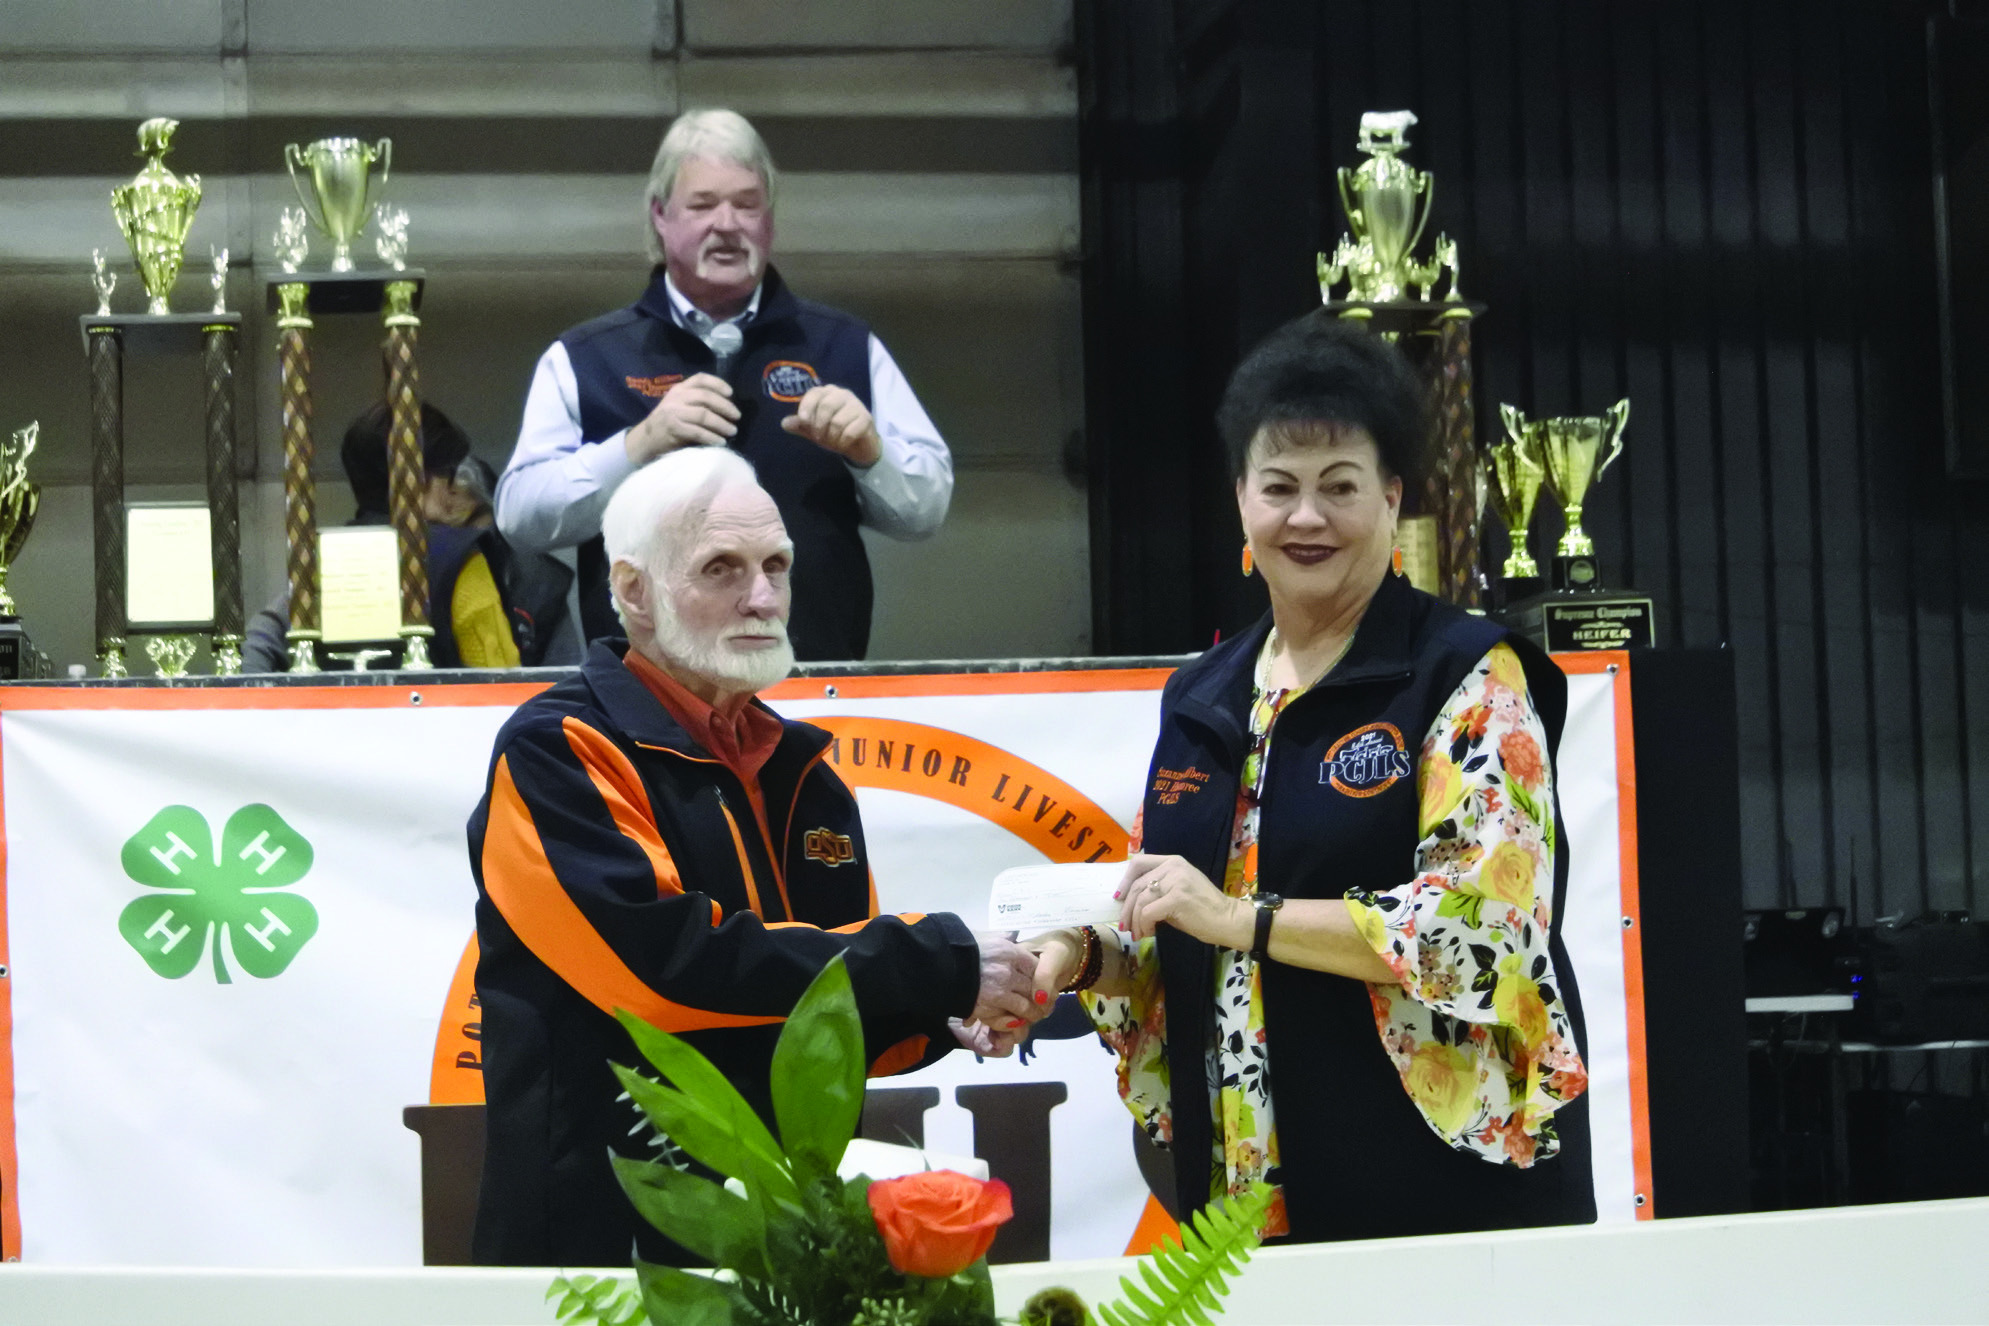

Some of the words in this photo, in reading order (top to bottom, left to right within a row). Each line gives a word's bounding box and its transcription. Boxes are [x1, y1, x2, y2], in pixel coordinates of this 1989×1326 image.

[1573, 629, 1631, 640] HEIFER
[991, 773, 1113, 863] LIVEST
[149, 830, 198, 876] H
[239, 829, 287, 876] H
[143, 908, 192, 955] H
[243, 906, 292, 953] H
